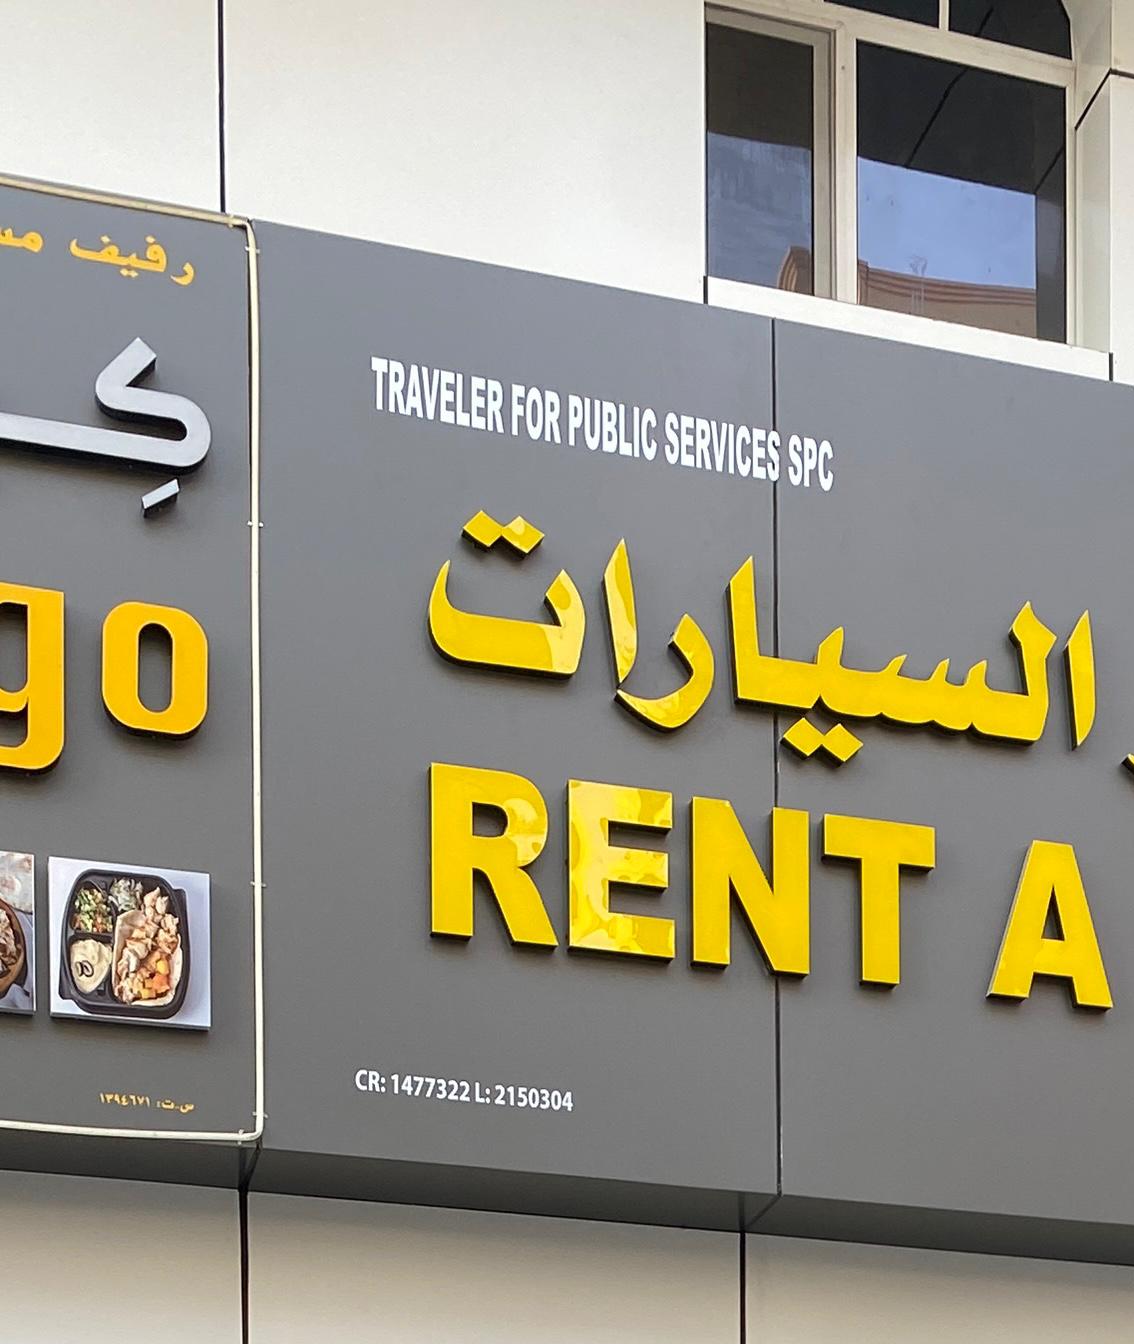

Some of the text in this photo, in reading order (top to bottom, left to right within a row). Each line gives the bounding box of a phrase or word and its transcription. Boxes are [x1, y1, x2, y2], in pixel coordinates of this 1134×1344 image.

[70, 235, 195, 286] رفيف
[371, 356, 835, 492] TRAVELER FOR PUBLIC SERVICES SPC
[427, 508, 1094, 766] السيارات
[427, 760, 937, 988] RENT
[985, 839, 1114, 1013] A
[355, 1069, 574, 1112] CR: 1477322 L: 2150304
